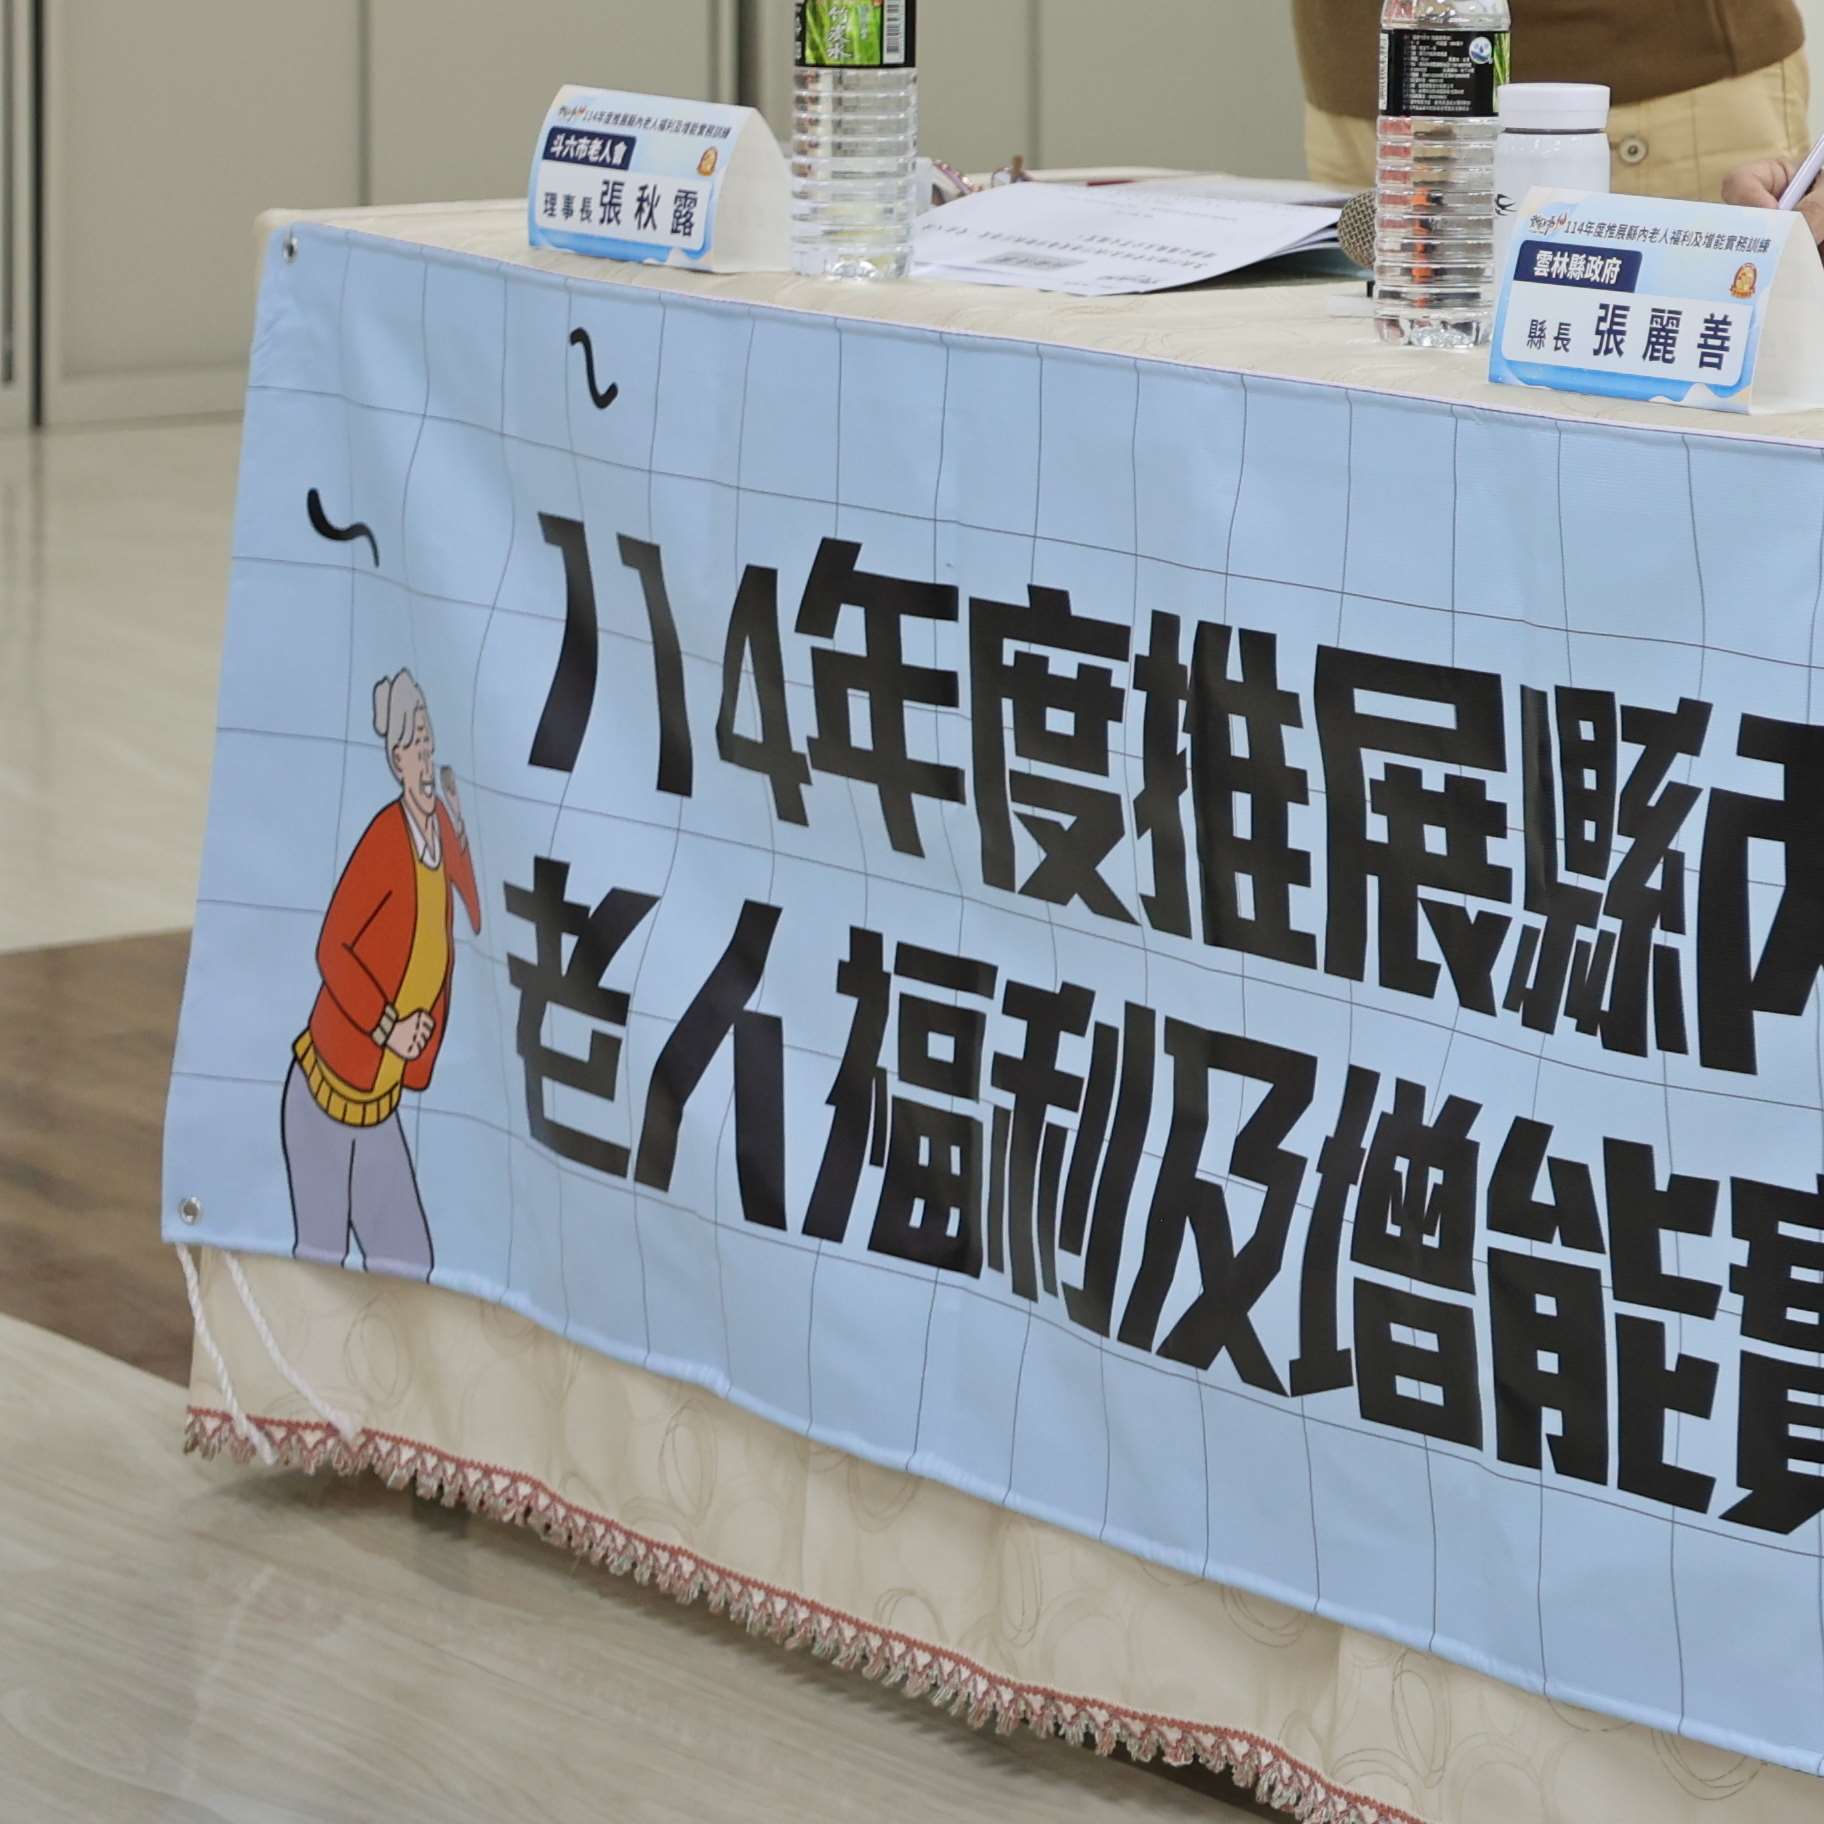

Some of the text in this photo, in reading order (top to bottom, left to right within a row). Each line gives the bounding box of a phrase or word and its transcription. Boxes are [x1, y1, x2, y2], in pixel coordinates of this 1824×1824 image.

[550, 133, 627, 165] 斗六市老人會
[543, 179, 698, 237] 理事長 張秋露
[1534, 250, 1622, 284] 雲林縣政府
[1526, 303, 1732, 371] 縣長 張麗善
